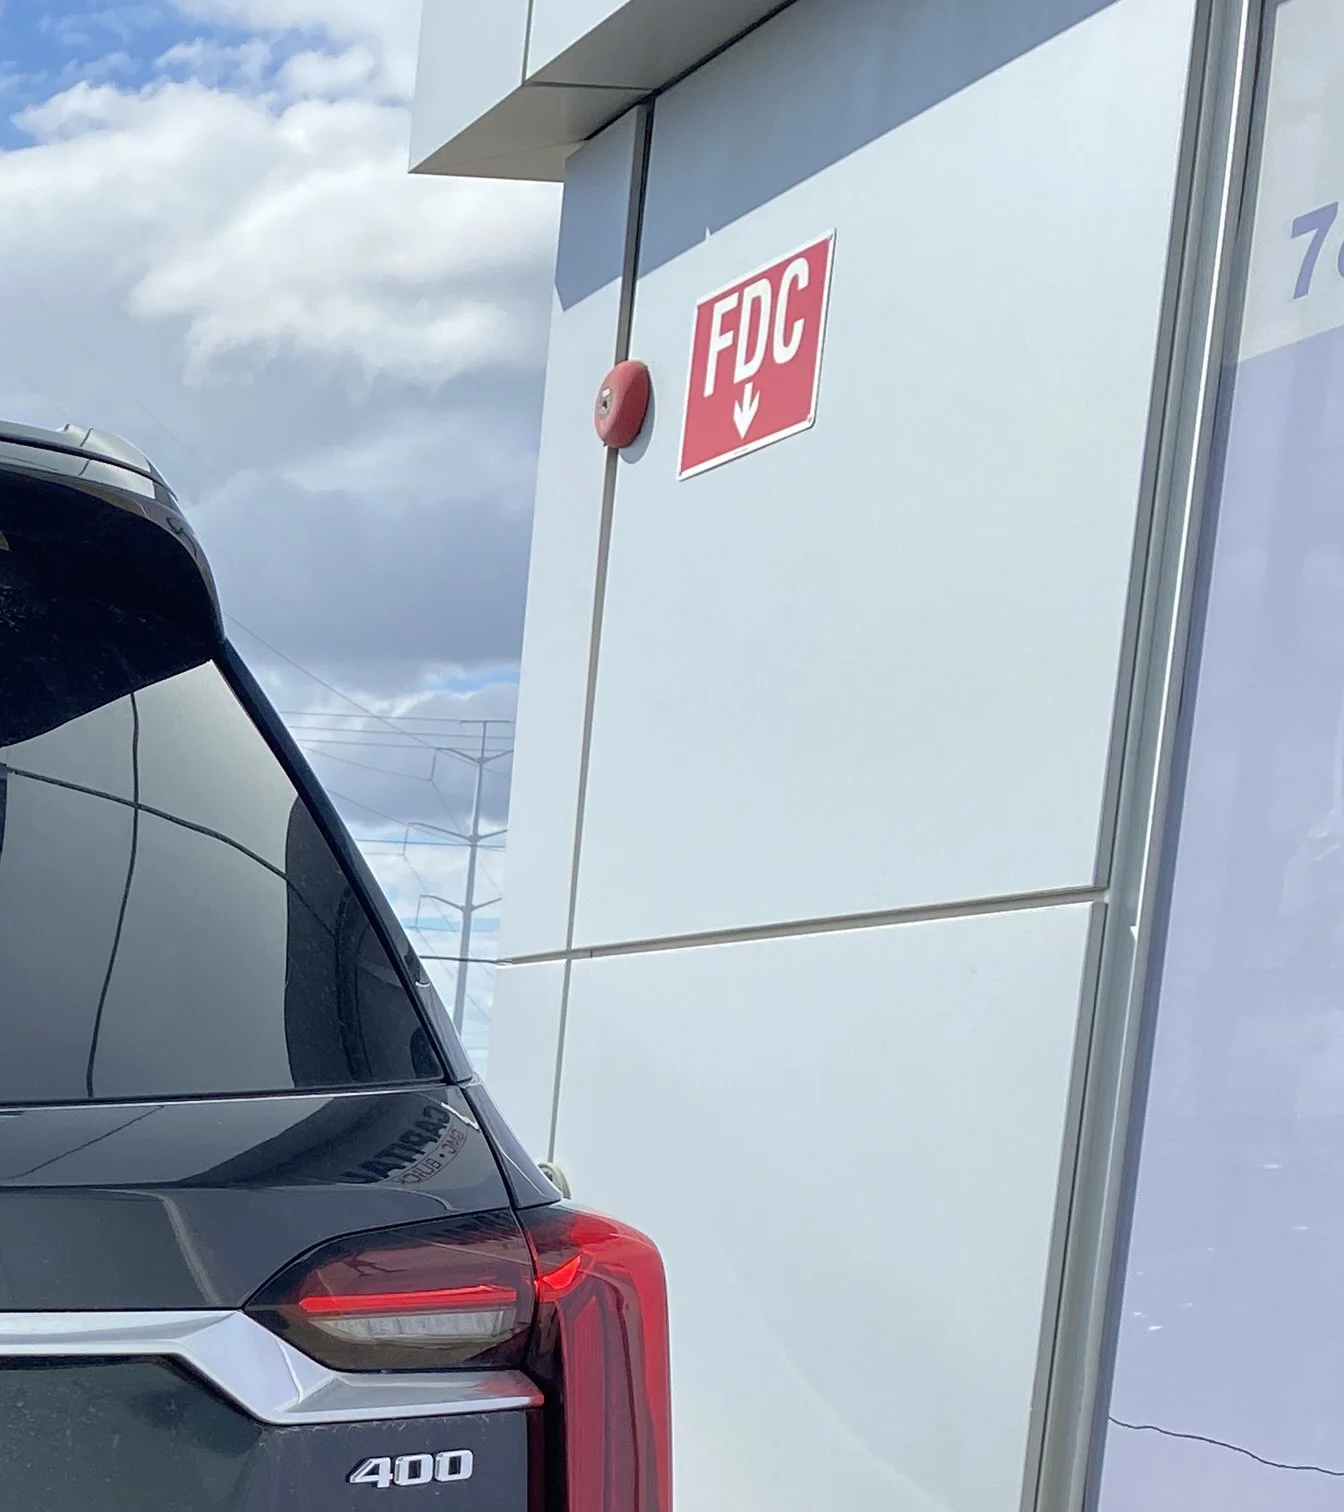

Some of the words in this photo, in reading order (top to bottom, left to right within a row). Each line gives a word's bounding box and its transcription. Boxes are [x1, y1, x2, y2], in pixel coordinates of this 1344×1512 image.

[1291, 201, 1344, 299] 7
[704, 257, 809, 397] FDC
[348, 1450, 474, 1488] 400
